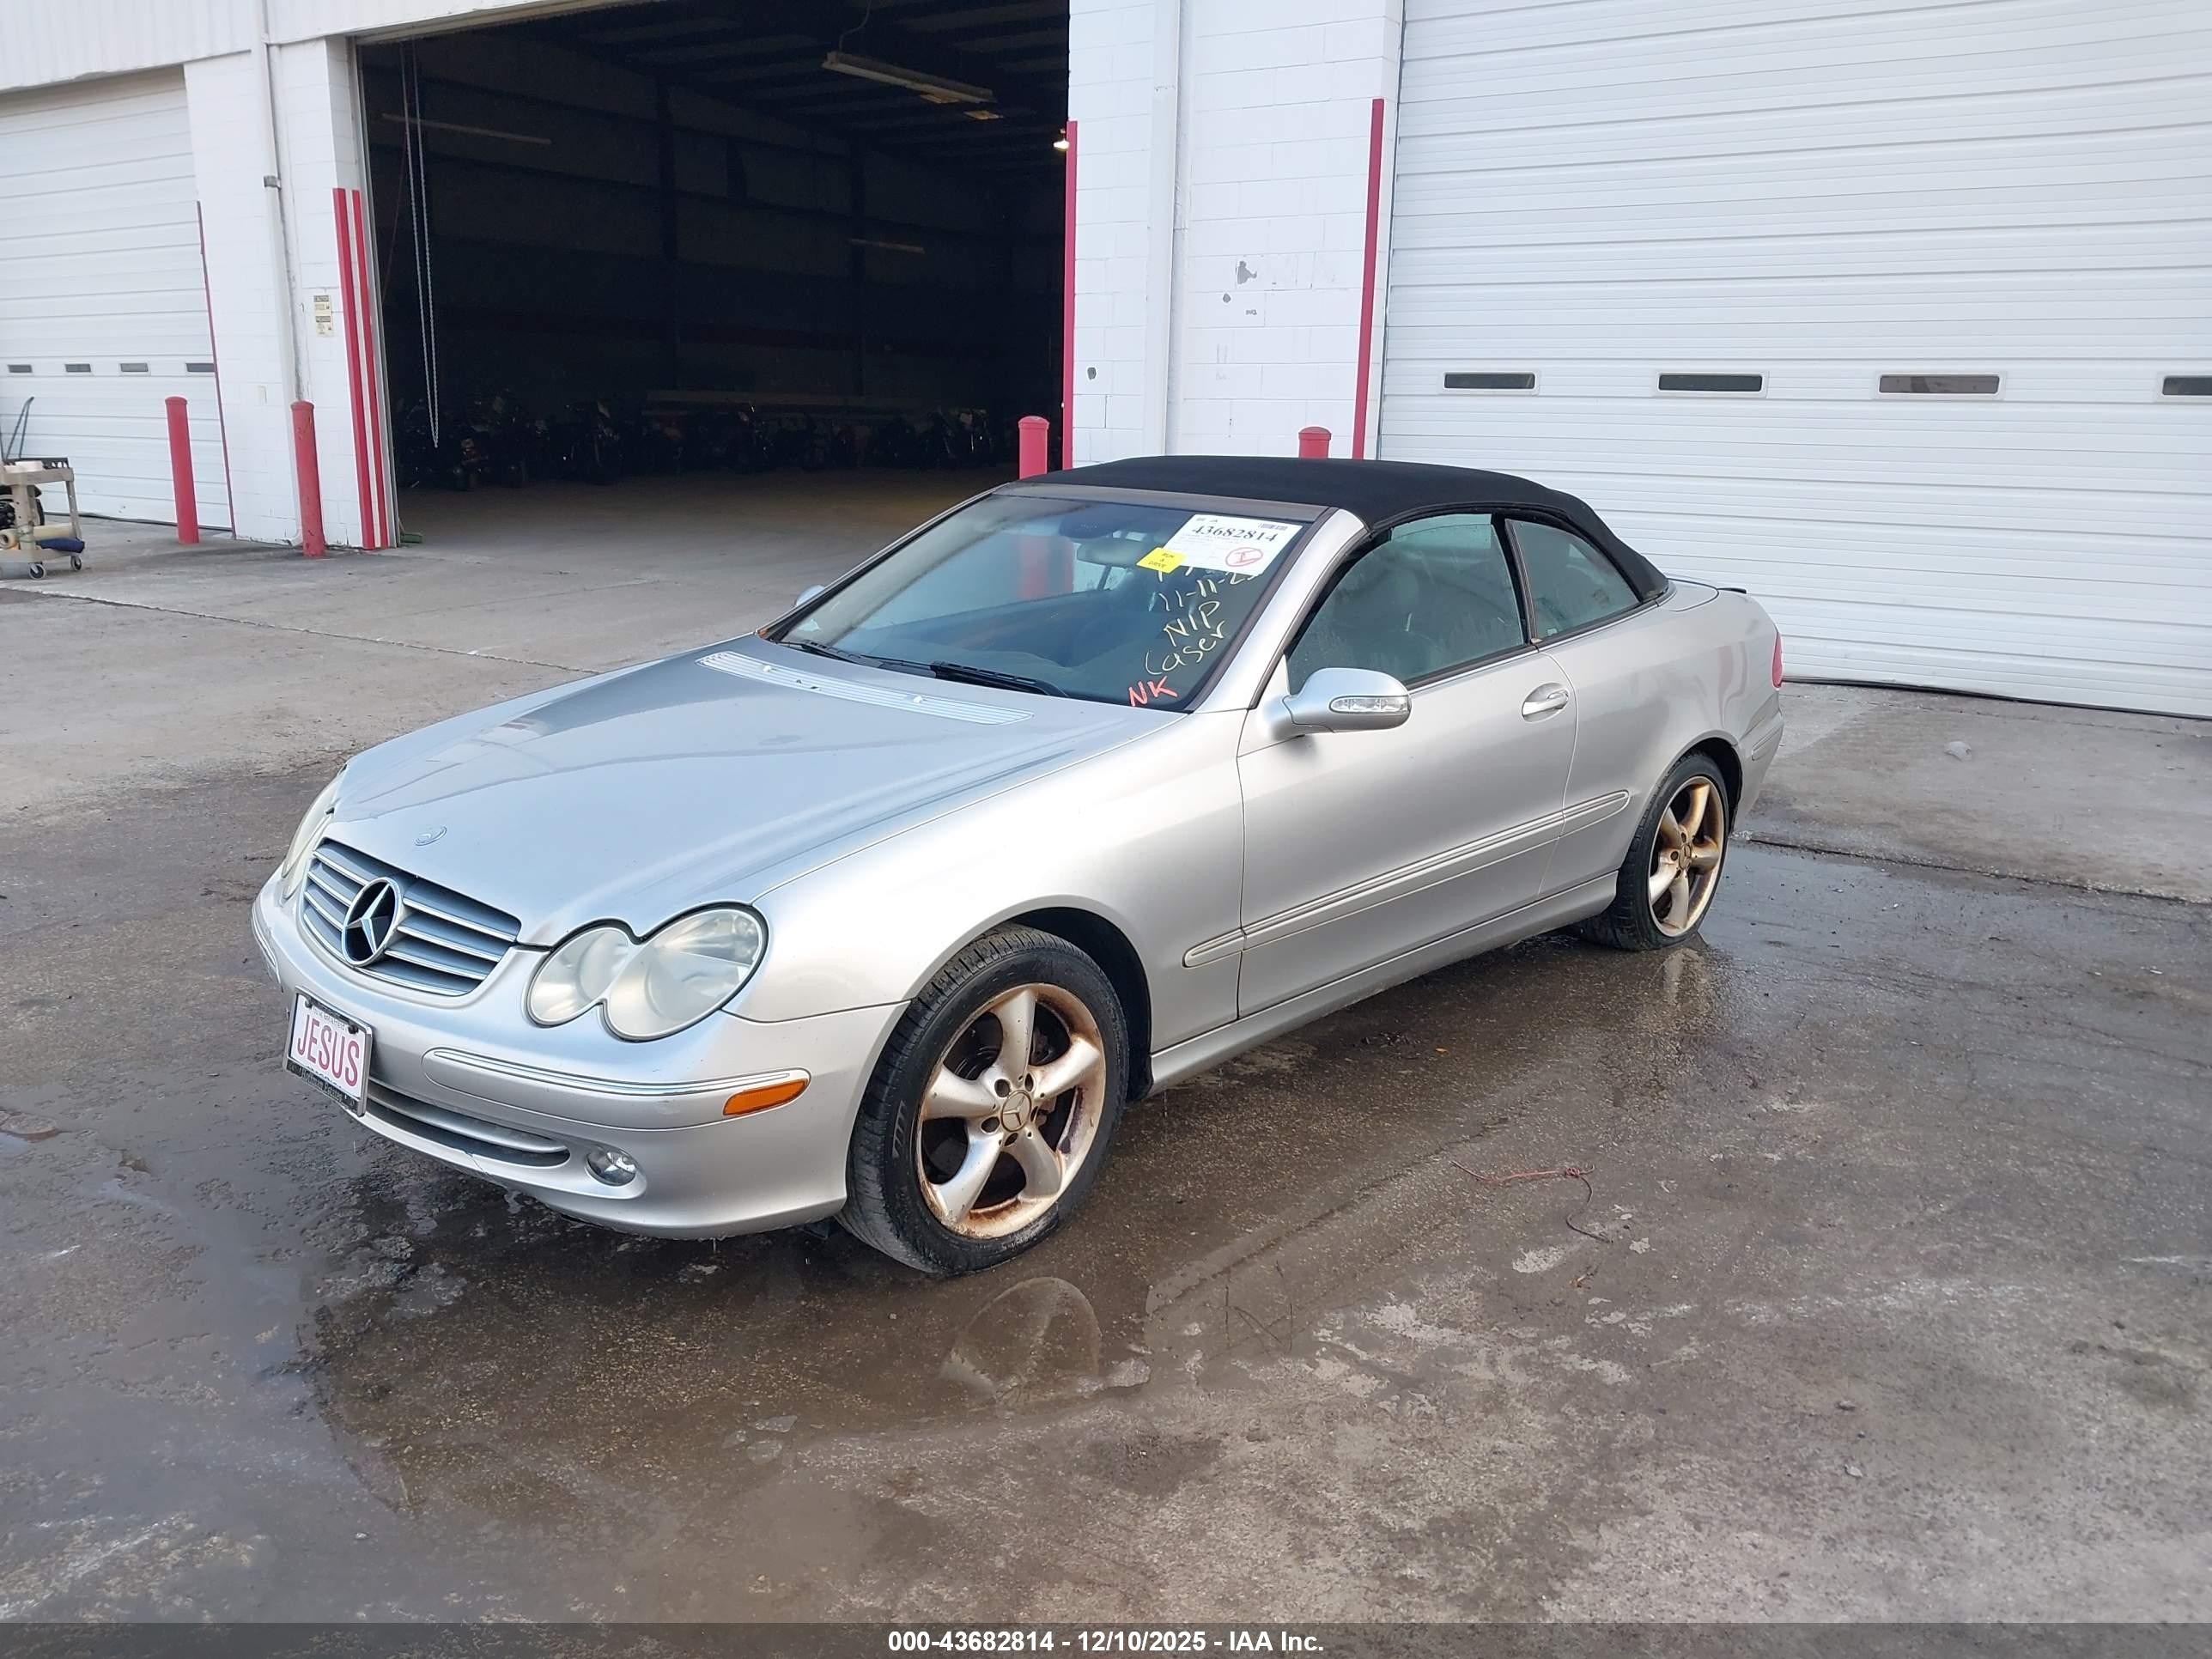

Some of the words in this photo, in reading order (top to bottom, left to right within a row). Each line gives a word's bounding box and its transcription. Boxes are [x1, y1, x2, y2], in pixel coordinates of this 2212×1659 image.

[1192, 525, 1279, 543] 43682814
[1127, 675, 1178, 707] NK
[297, 1014, 360, 1087] JESUS
